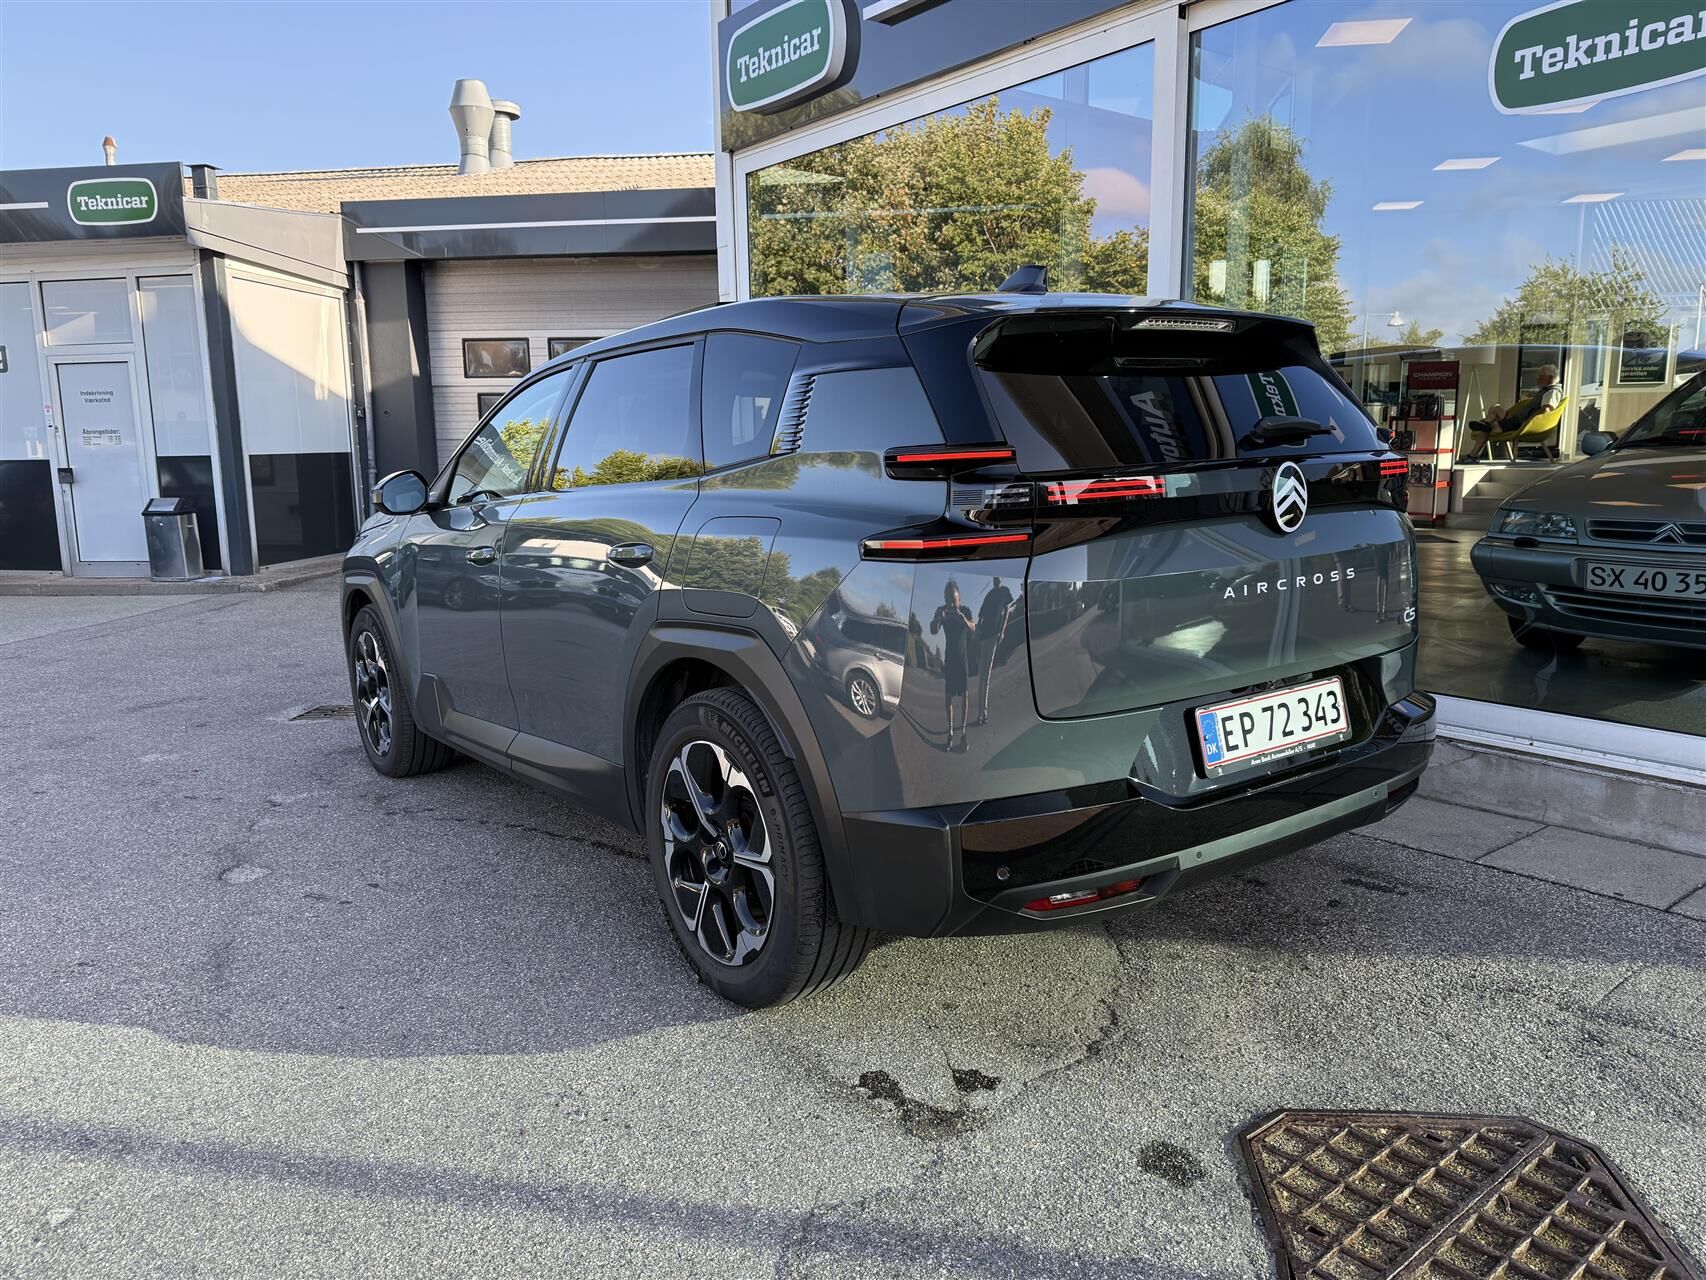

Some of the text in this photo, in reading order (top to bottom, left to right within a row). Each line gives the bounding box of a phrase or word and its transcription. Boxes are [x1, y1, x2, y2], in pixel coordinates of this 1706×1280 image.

[736, 26, 822, 83] Teknicar
[76, 193, 149, 211] Teknicar
[1223, 567, 1356, 599] AIRCROSS
[1590, 566, 1706, 595] SX 40 35
[1221, 690, 1341, 752] EP 72 343
[719, 720, 771, 794] MICHELIN
[1207, 743, 1219, 755] DK
